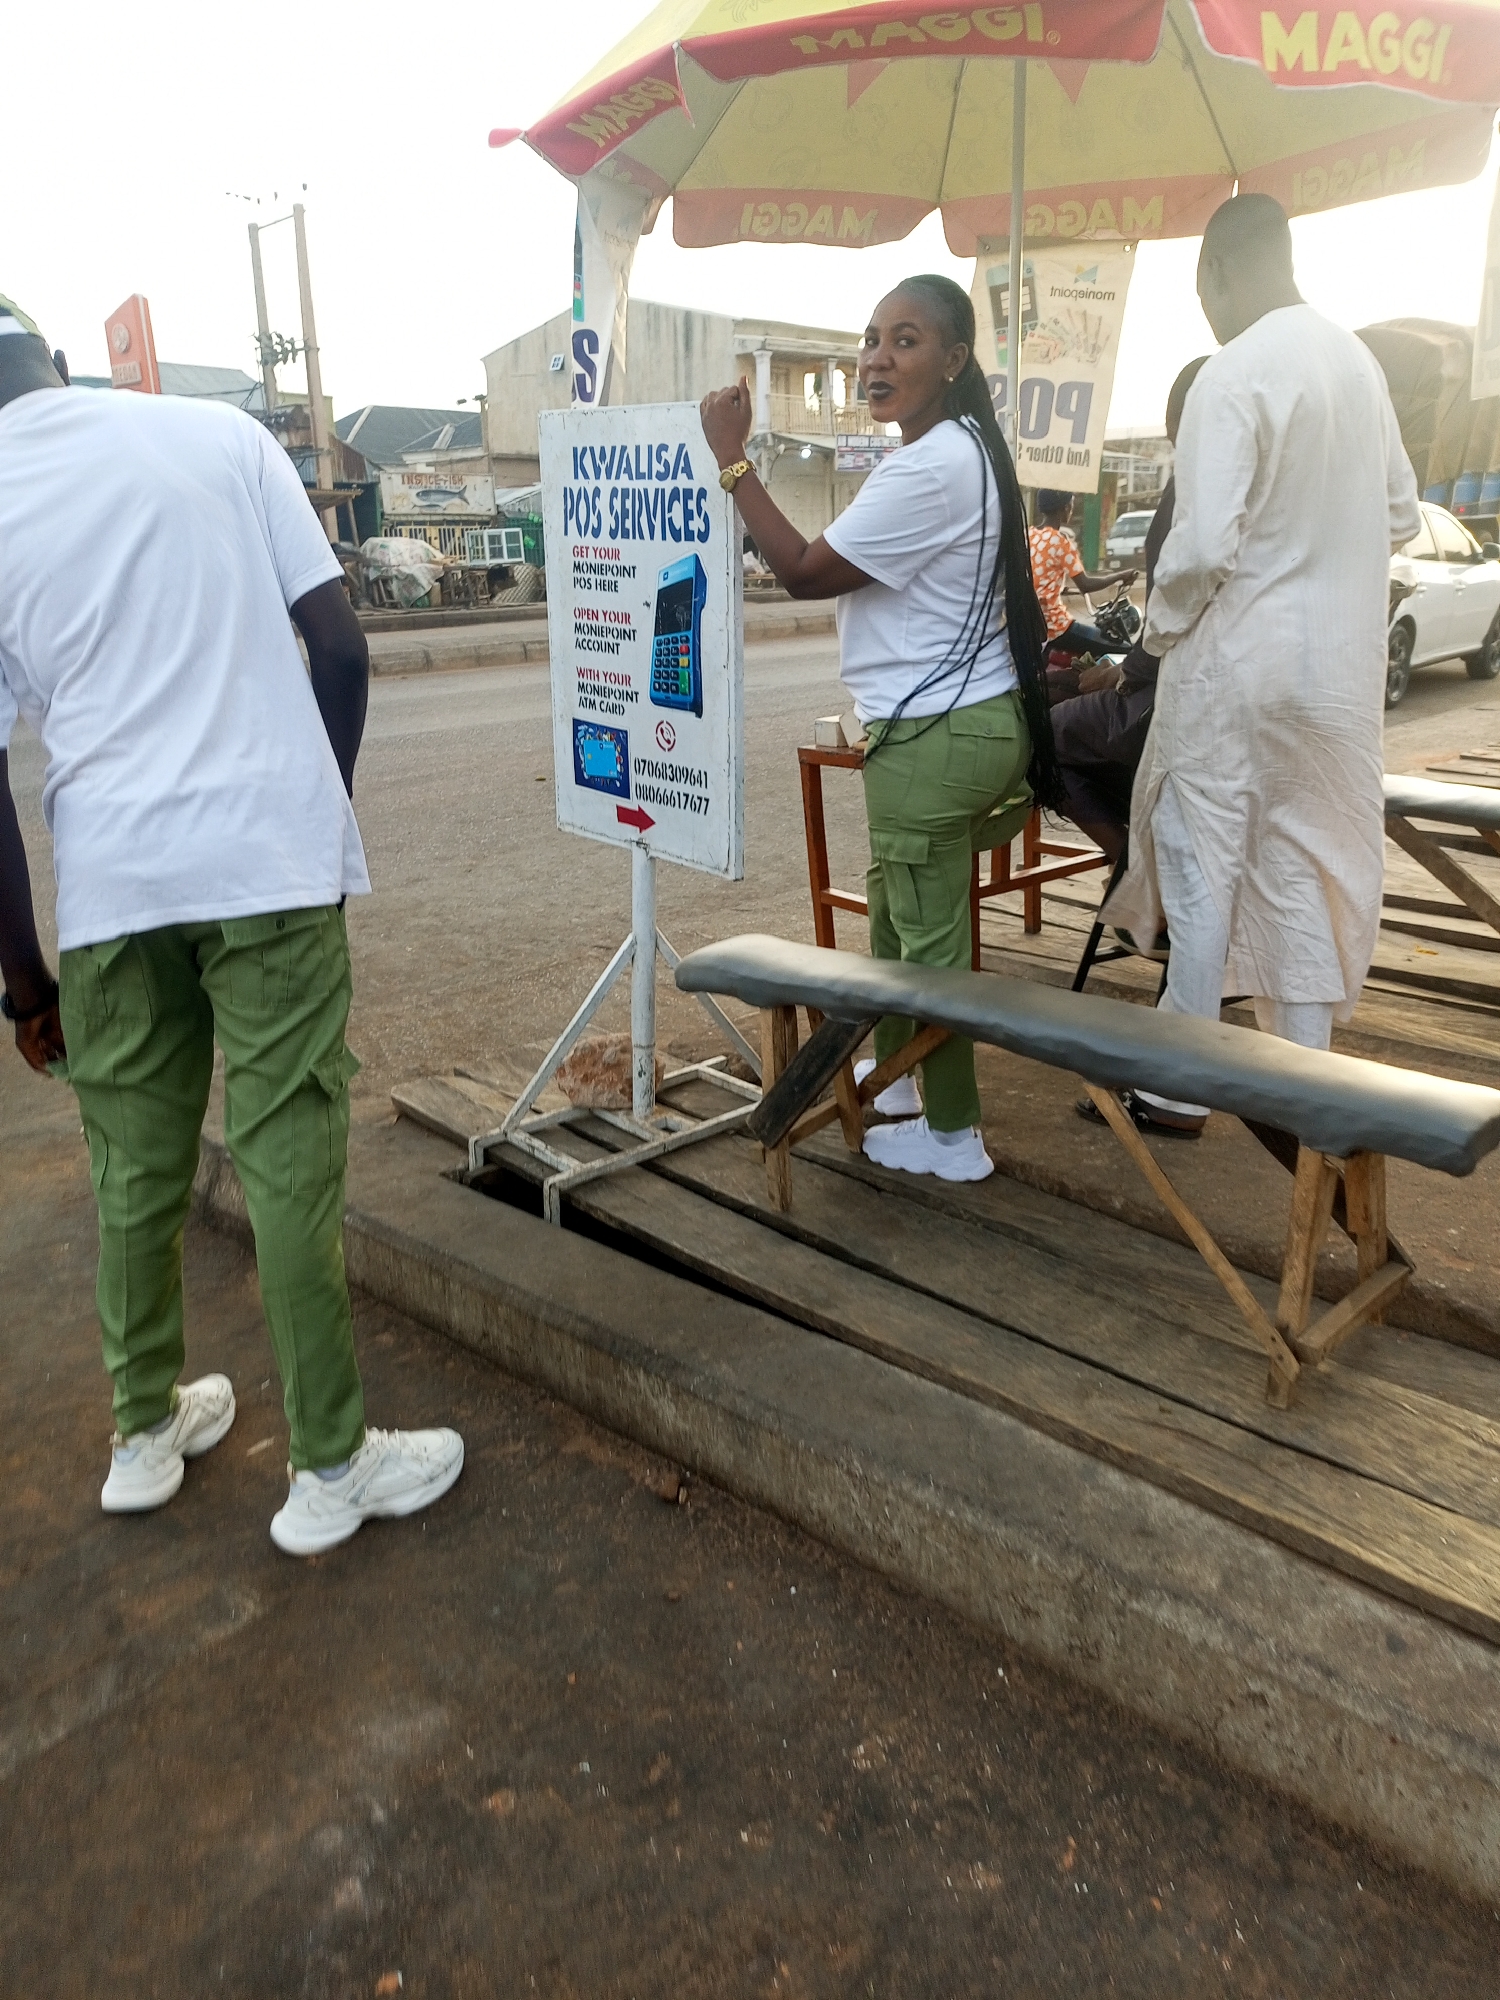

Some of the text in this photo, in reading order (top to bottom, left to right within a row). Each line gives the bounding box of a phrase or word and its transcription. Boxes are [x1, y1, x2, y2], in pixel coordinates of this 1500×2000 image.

[1260, 11, 1453, 83] MAGGI
[565, 75, 681, 148] MAGGI
[572, 442, 694, 482] KWALISA
[563, 486, 711, 544] POS SERVICES
[572, 545, 620, 561] GET YOUR
[573, 560, 637, 579] MONIEPOINT
[573, 576, 618, 593] POS HERE
[574, 607, 631, 625] OPEN YOUR
[574, 622, 637, 642] MONIEPOINT
[575, 637, 620, 655] ACCOUNT
[576, 666, 631, 687] WITH YOUR
[578, 681, 639, 703] MONIEPOINT
[578, 696, 625, 716] ATM CARD
[634, 757, 708, 789] 07068309641
[635, 782, 710, 816] 08066617677
